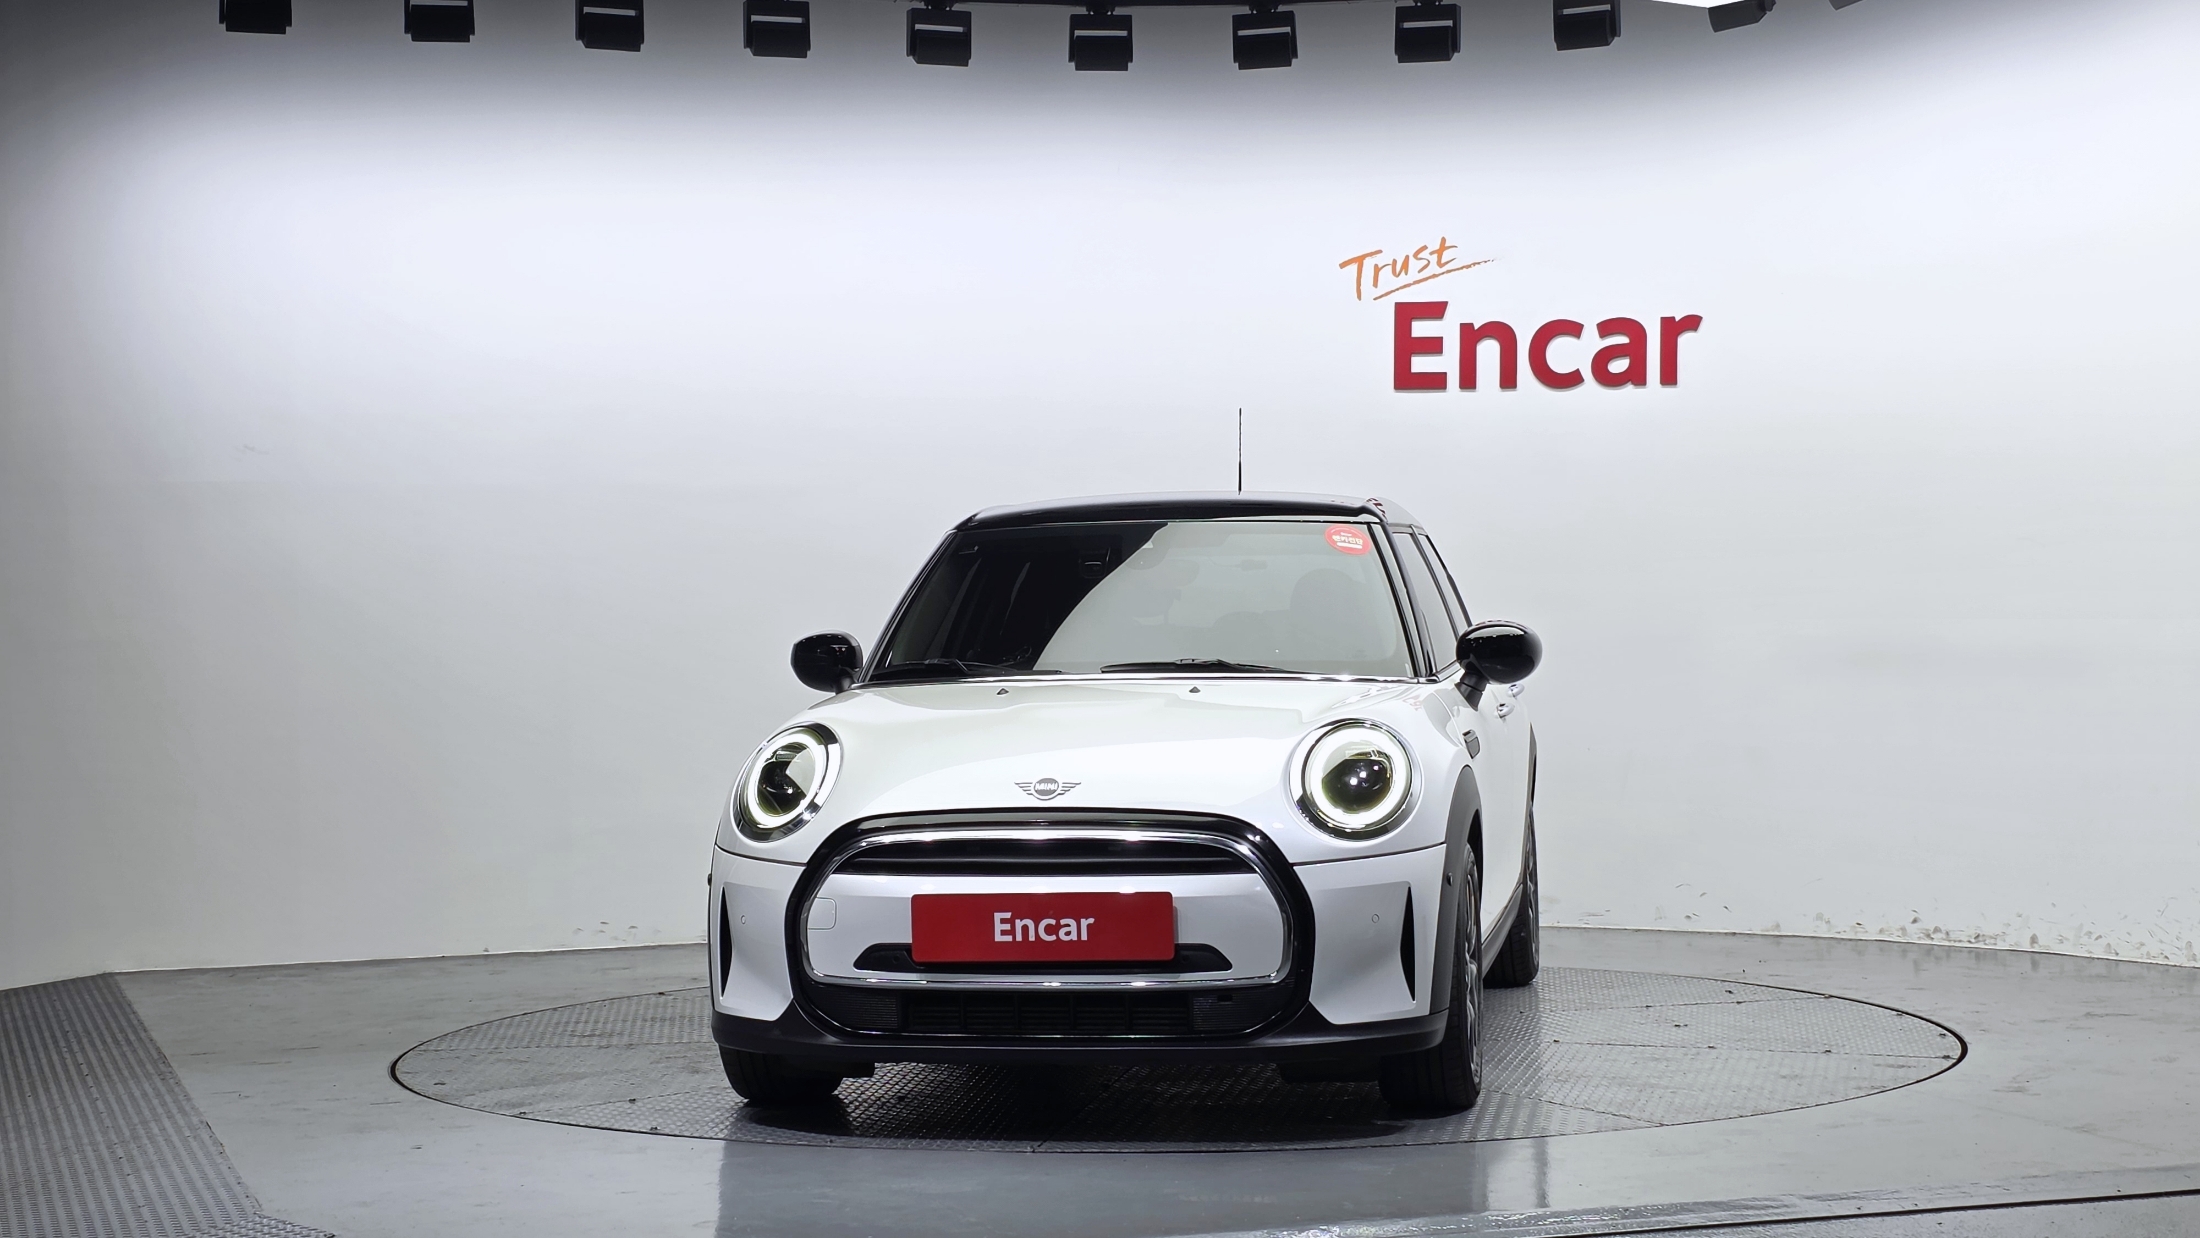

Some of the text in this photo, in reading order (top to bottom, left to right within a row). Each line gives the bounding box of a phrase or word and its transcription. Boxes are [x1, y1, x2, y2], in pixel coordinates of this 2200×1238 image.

[1338, 236, 1459, 302] Trust
[1394, 301, 1703, 391] Encar
[1035, 782, 1058, 791] MINI
[994, 912, 1095, 942] Encar
